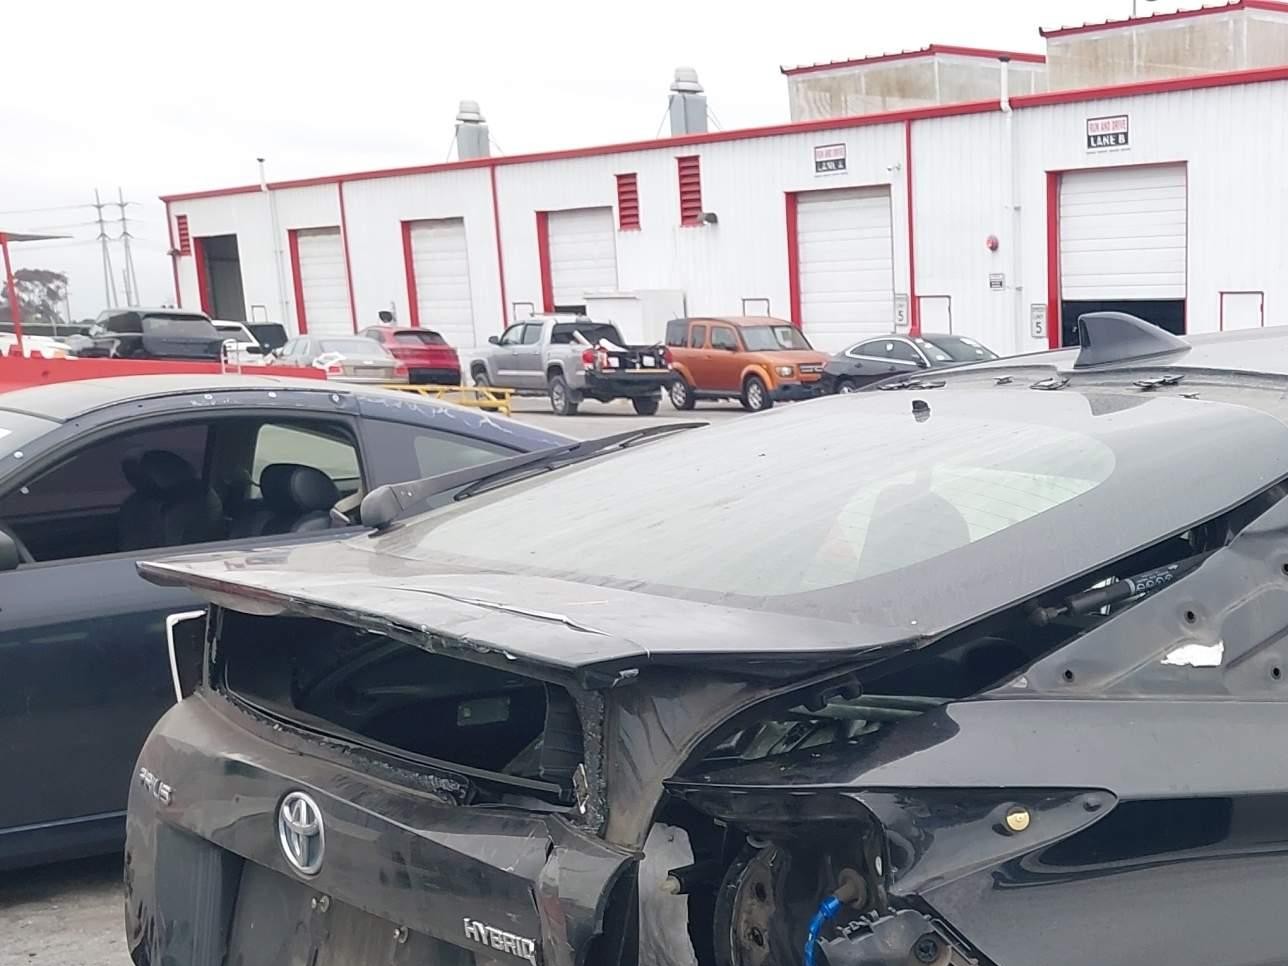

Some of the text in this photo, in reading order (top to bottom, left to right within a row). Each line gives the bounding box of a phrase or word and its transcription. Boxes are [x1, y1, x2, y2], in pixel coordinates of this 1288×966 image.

[1090, 133, 1126, 147] LANE B
[1035, 321, 1042, 334] 5
